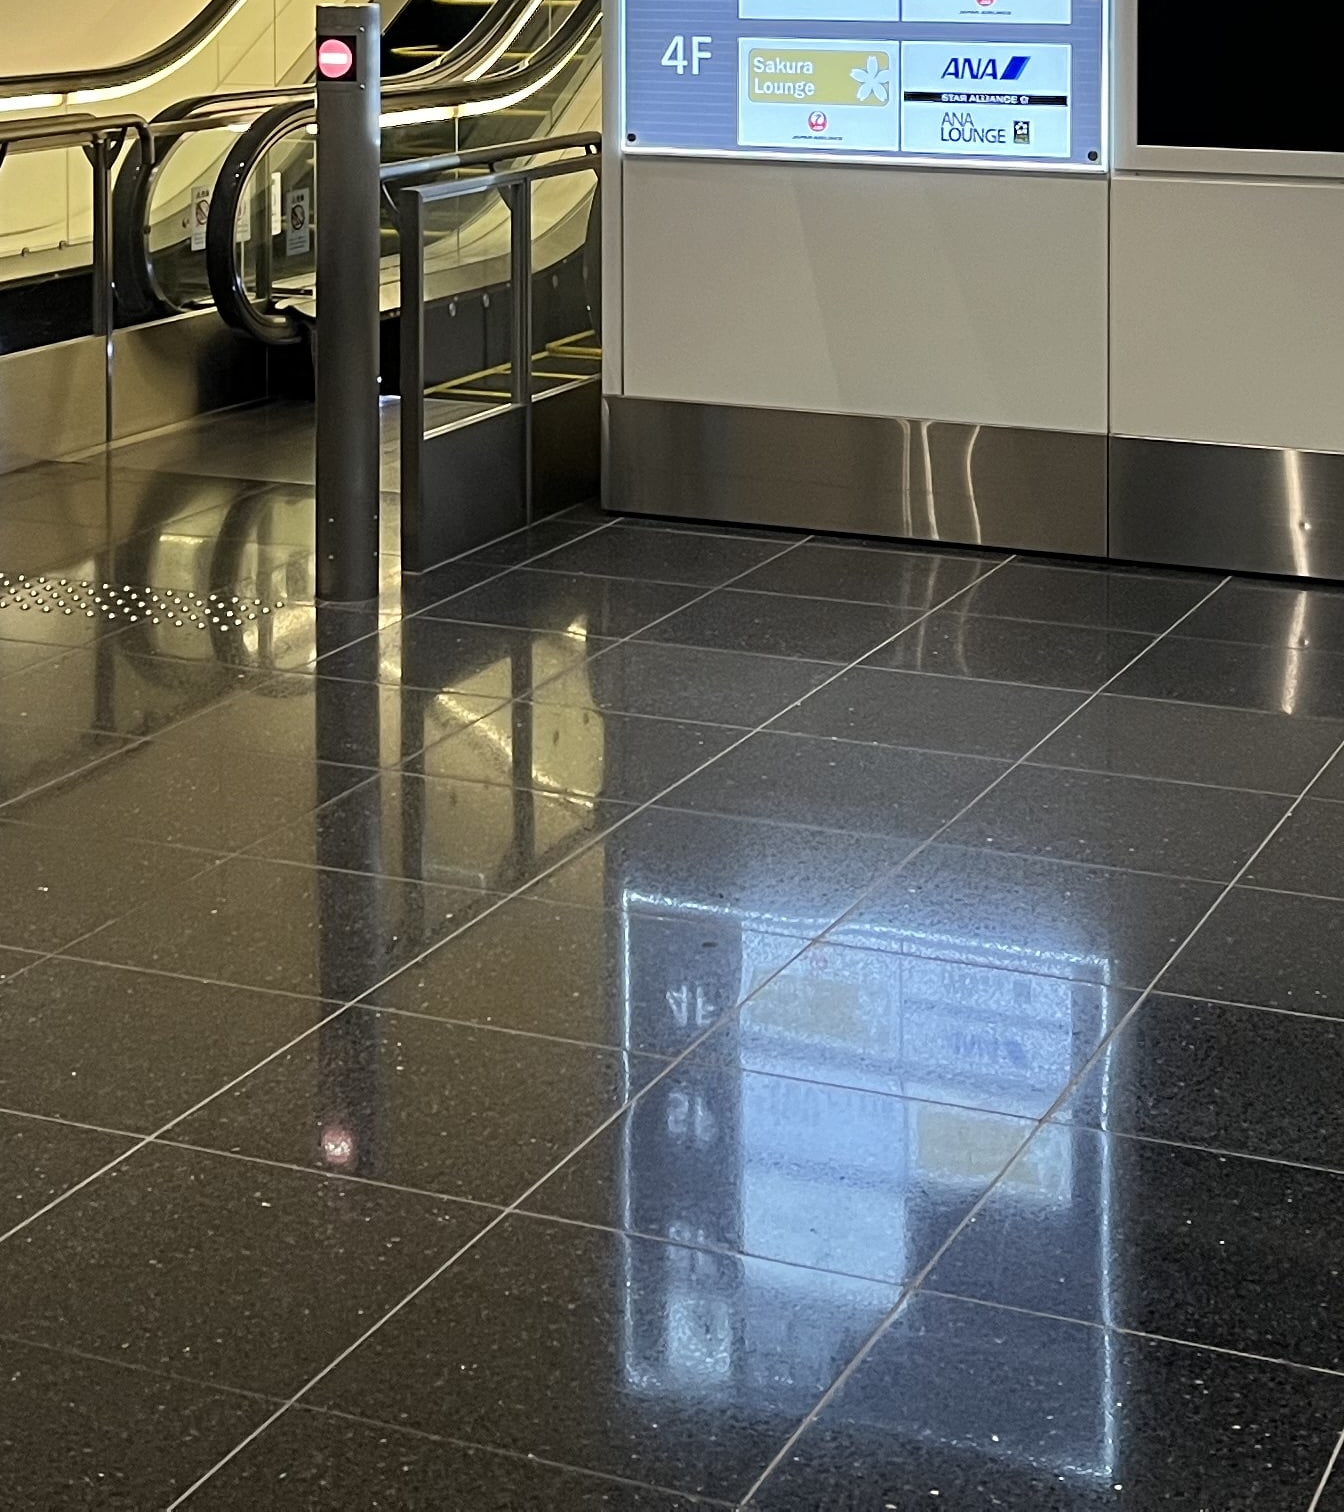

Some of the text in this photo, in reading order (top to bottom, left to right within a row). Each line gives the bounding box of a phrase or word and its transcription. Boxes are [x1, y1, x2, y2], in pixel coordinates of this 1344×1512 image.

[661, 36, 712, 75] 4F
[754, 57, 813, 74] Sakura
[941, 58, 997, 80] ANA
[755, 79, 815, 97] Lounge
[941, 94, 1017, 104] STAR ALLIANCE
[941, 113, 973, 126] ANA
[941, 128, 1006, 143] LOUNGE
